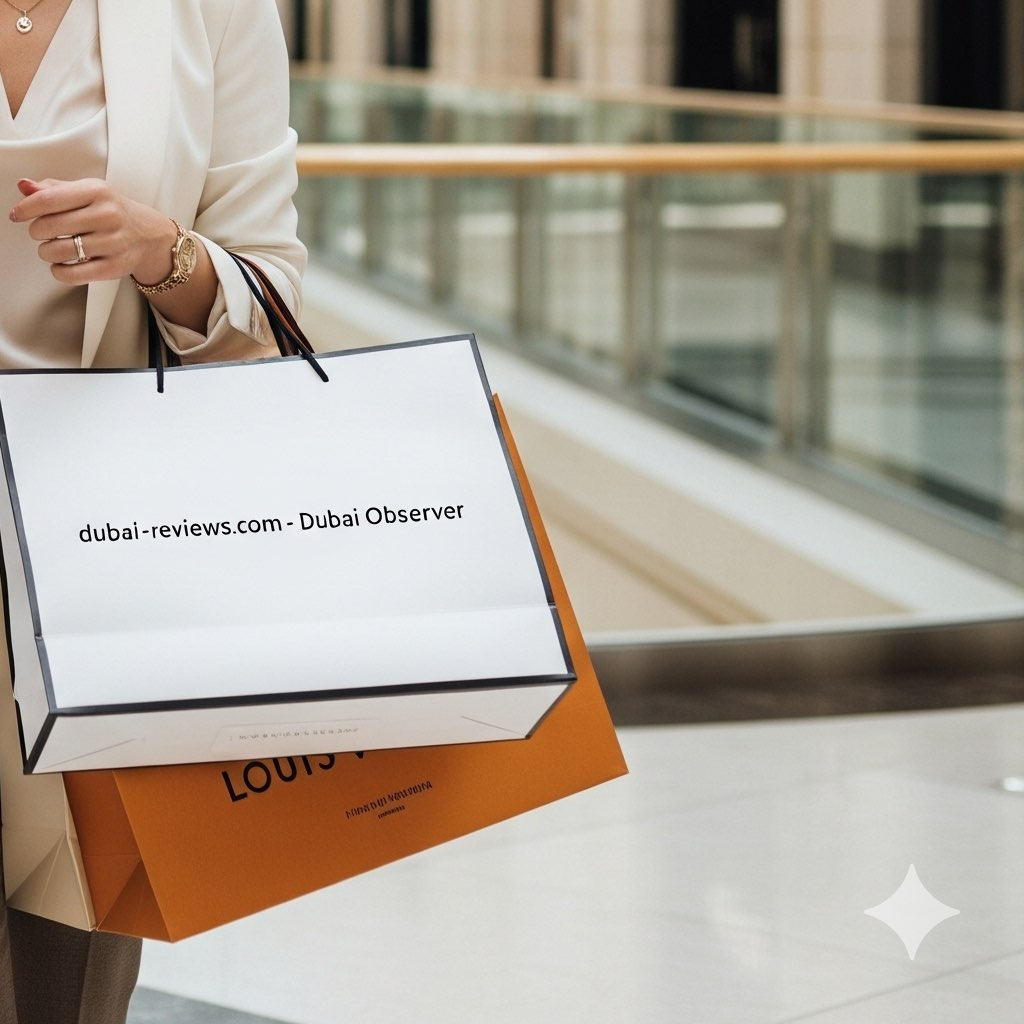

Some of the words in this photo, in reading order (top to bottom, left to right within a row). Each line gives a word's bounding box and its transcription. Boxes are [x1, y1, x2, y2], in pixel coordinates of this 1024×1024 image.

[78, 518, 283, 543] dubai-reviews.com
[298, 507, 360, 531] Dubai
[365, 504, 465, 525] Observer
